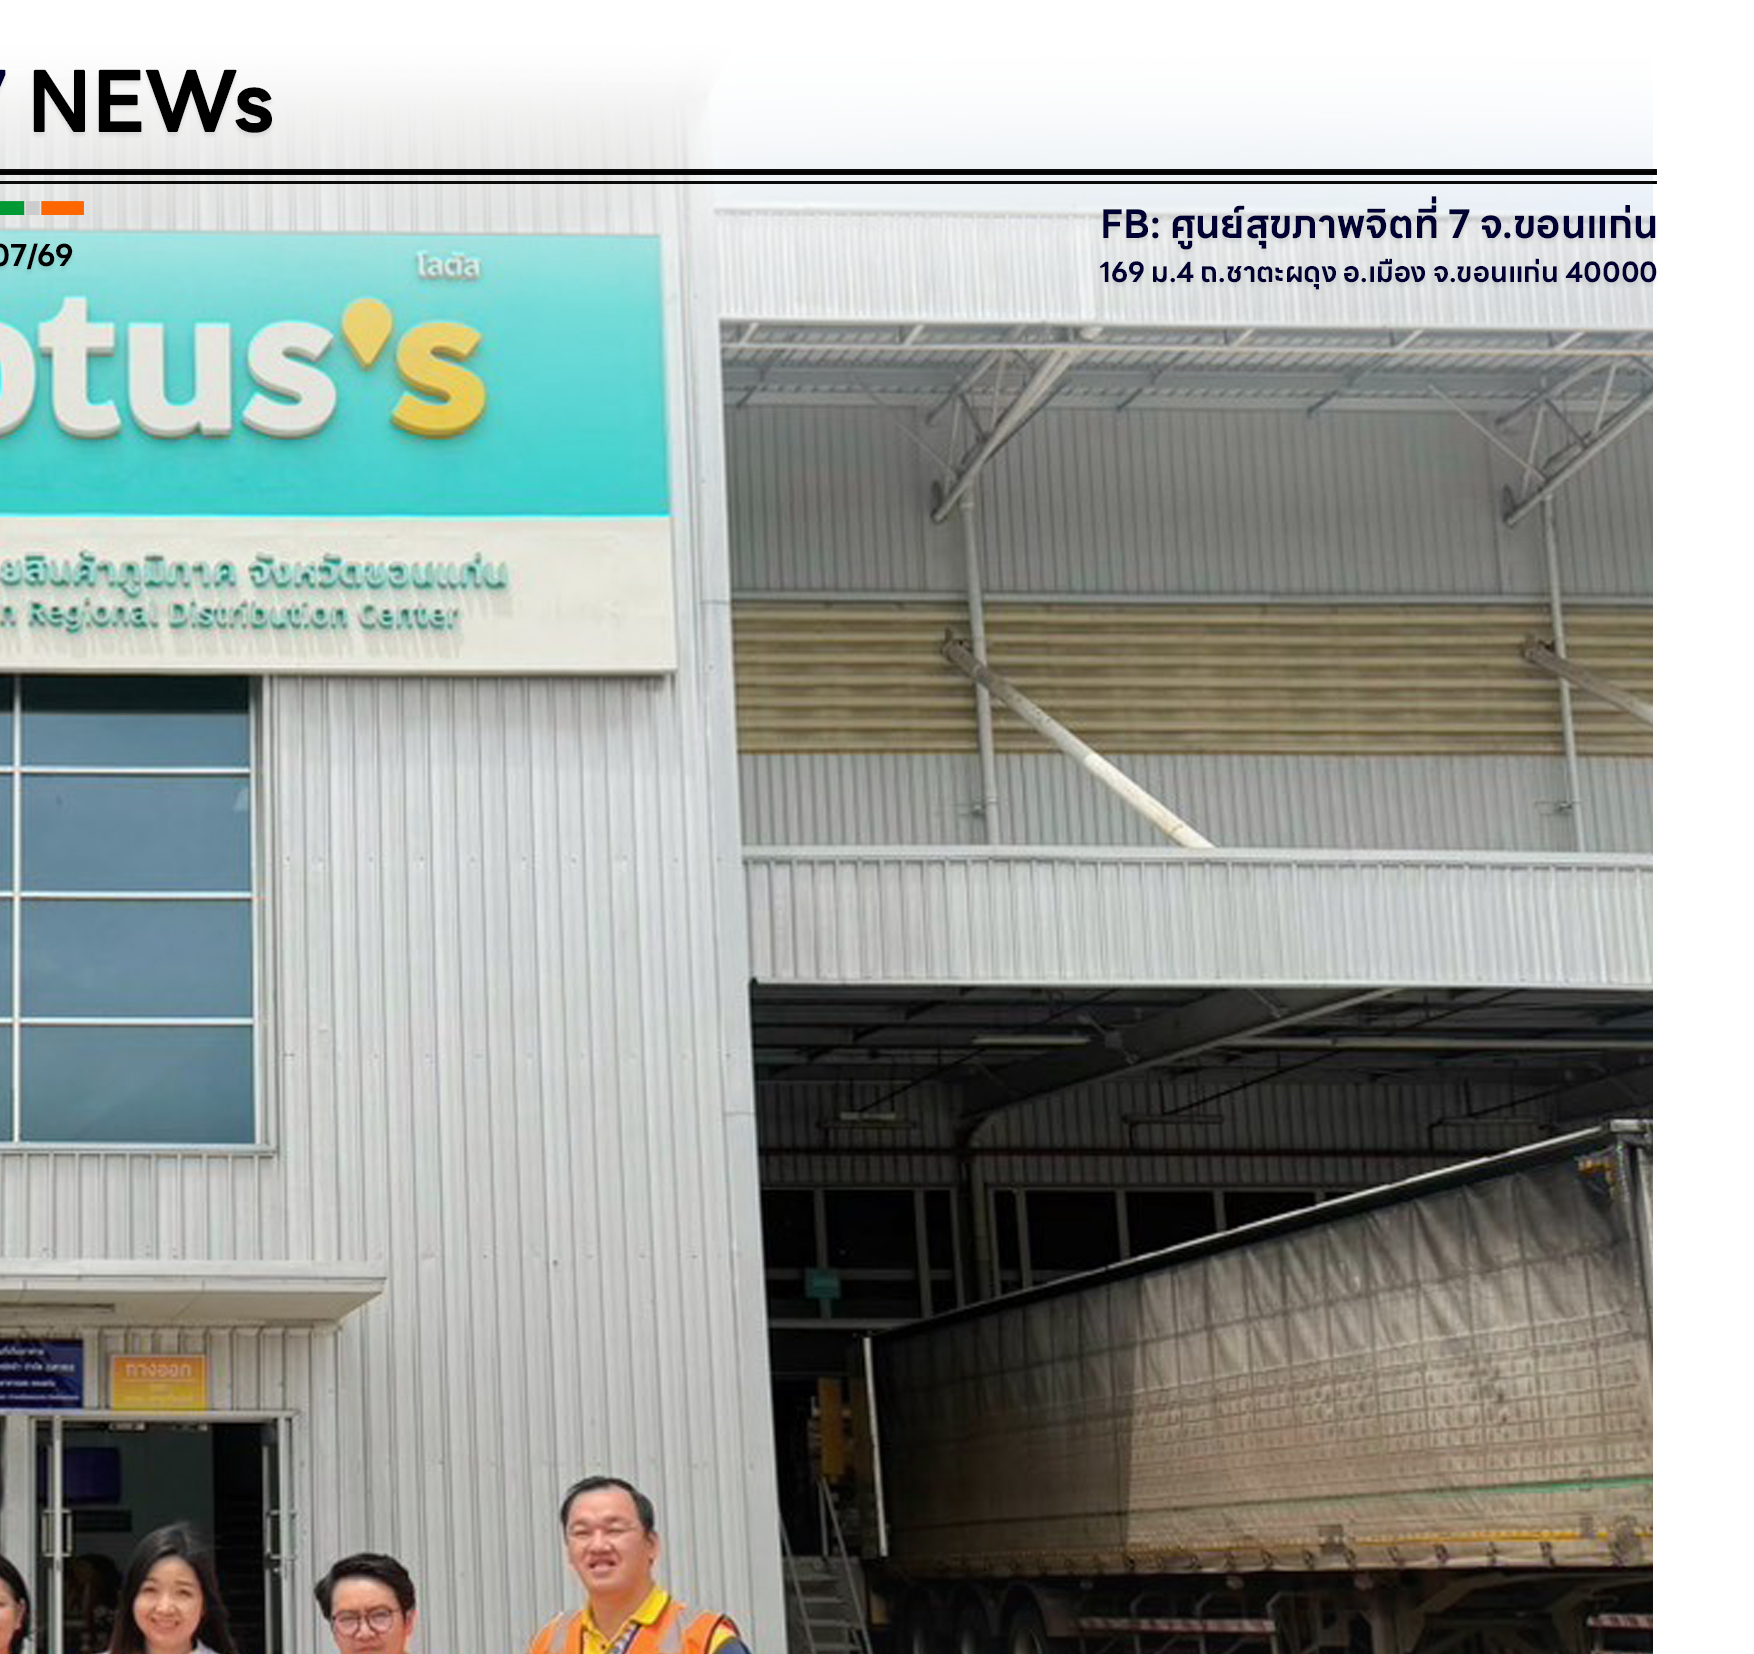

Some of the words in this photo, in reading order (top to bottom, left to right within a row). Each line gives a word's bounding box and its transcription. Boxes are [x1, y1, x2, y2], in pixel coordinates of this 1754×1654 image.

[415, 249, 483, 282] โลตัส
[248, 552, 509, 592] จังหวัดขอนแก่น
[28, 599, 158, 634] Regional
[168, 600, 349, 631] Distribution
[358, 602, 461, 632] Center
